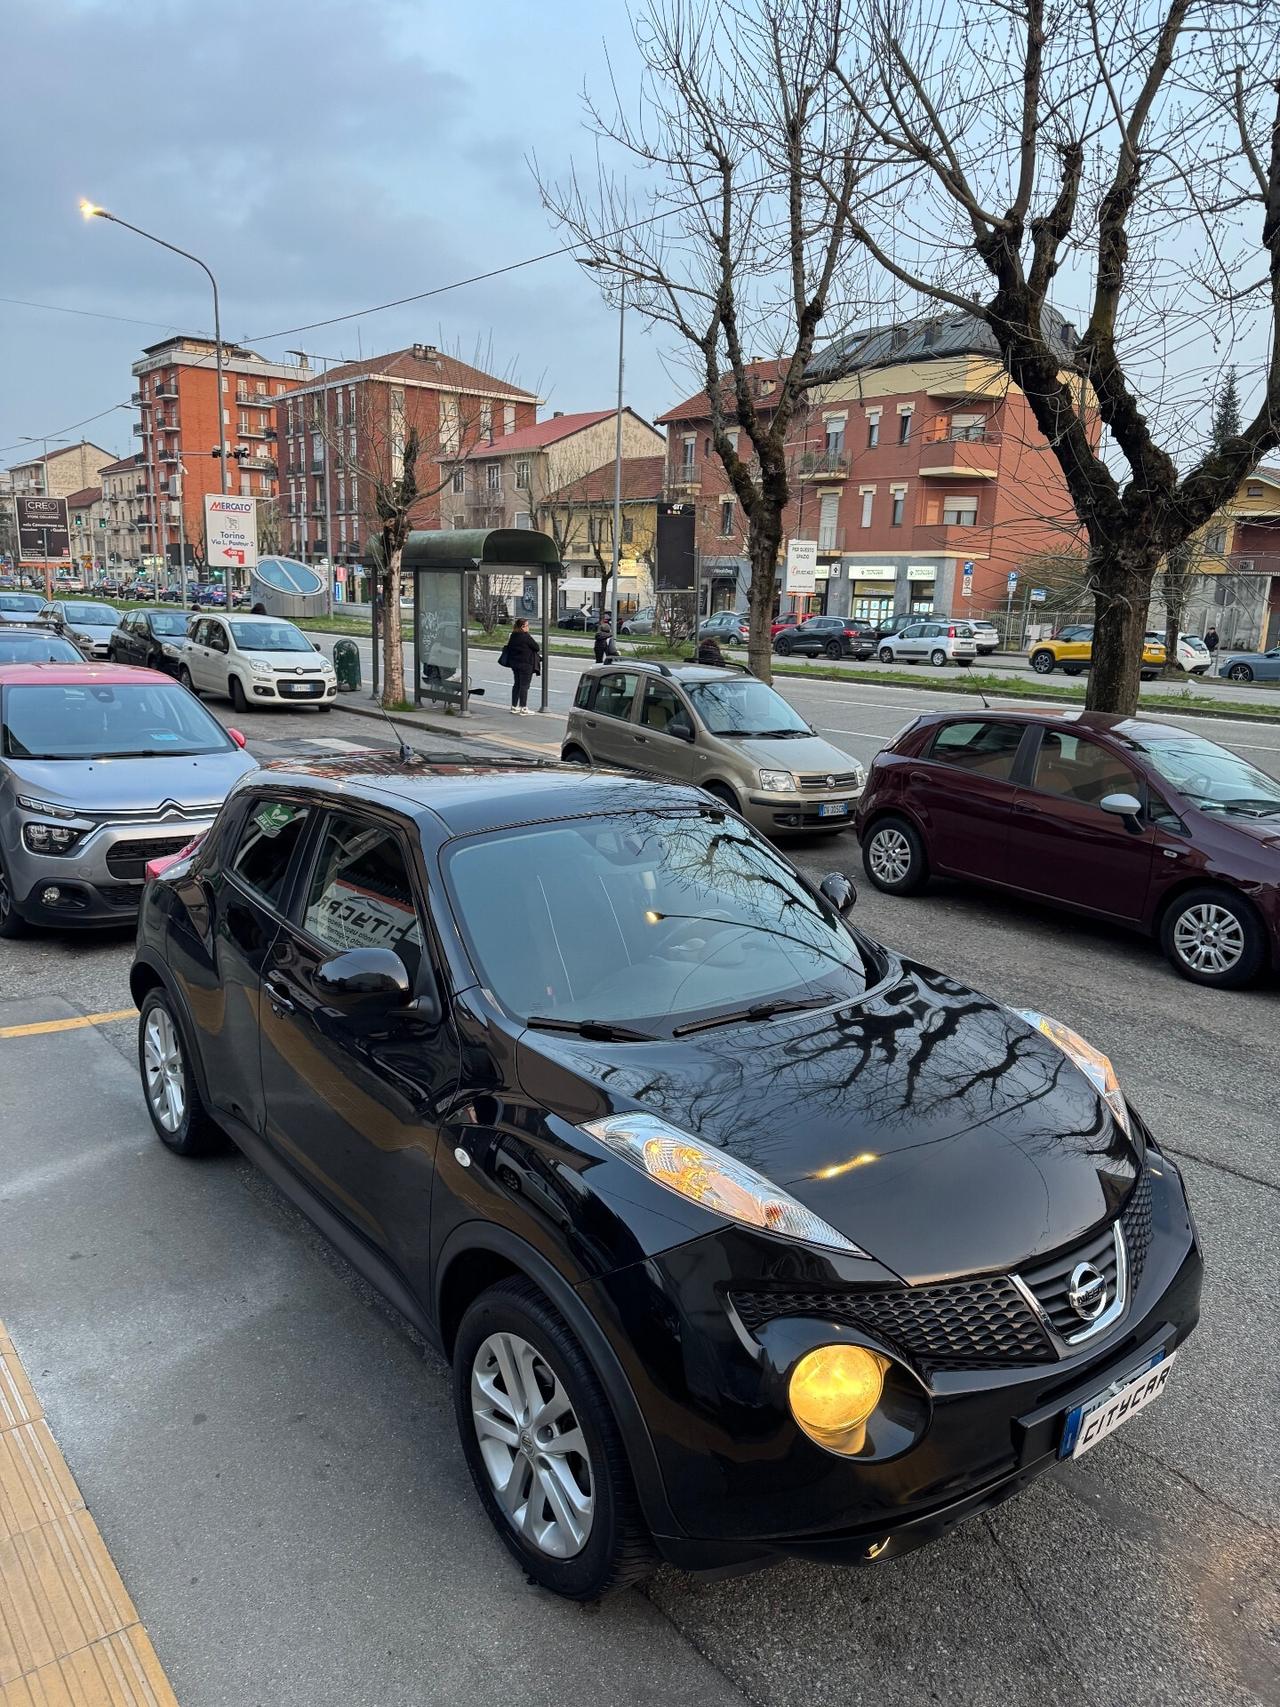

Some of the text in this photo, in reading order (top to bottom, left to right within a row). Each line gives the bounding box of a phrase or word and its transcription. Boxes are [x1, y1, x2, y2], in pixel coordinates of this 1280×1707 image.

[27, 501, 57, 510] CREO
[220, 531, 245, 540] Torino
[1083, 1365, 1171, 1445] CITYCAR
